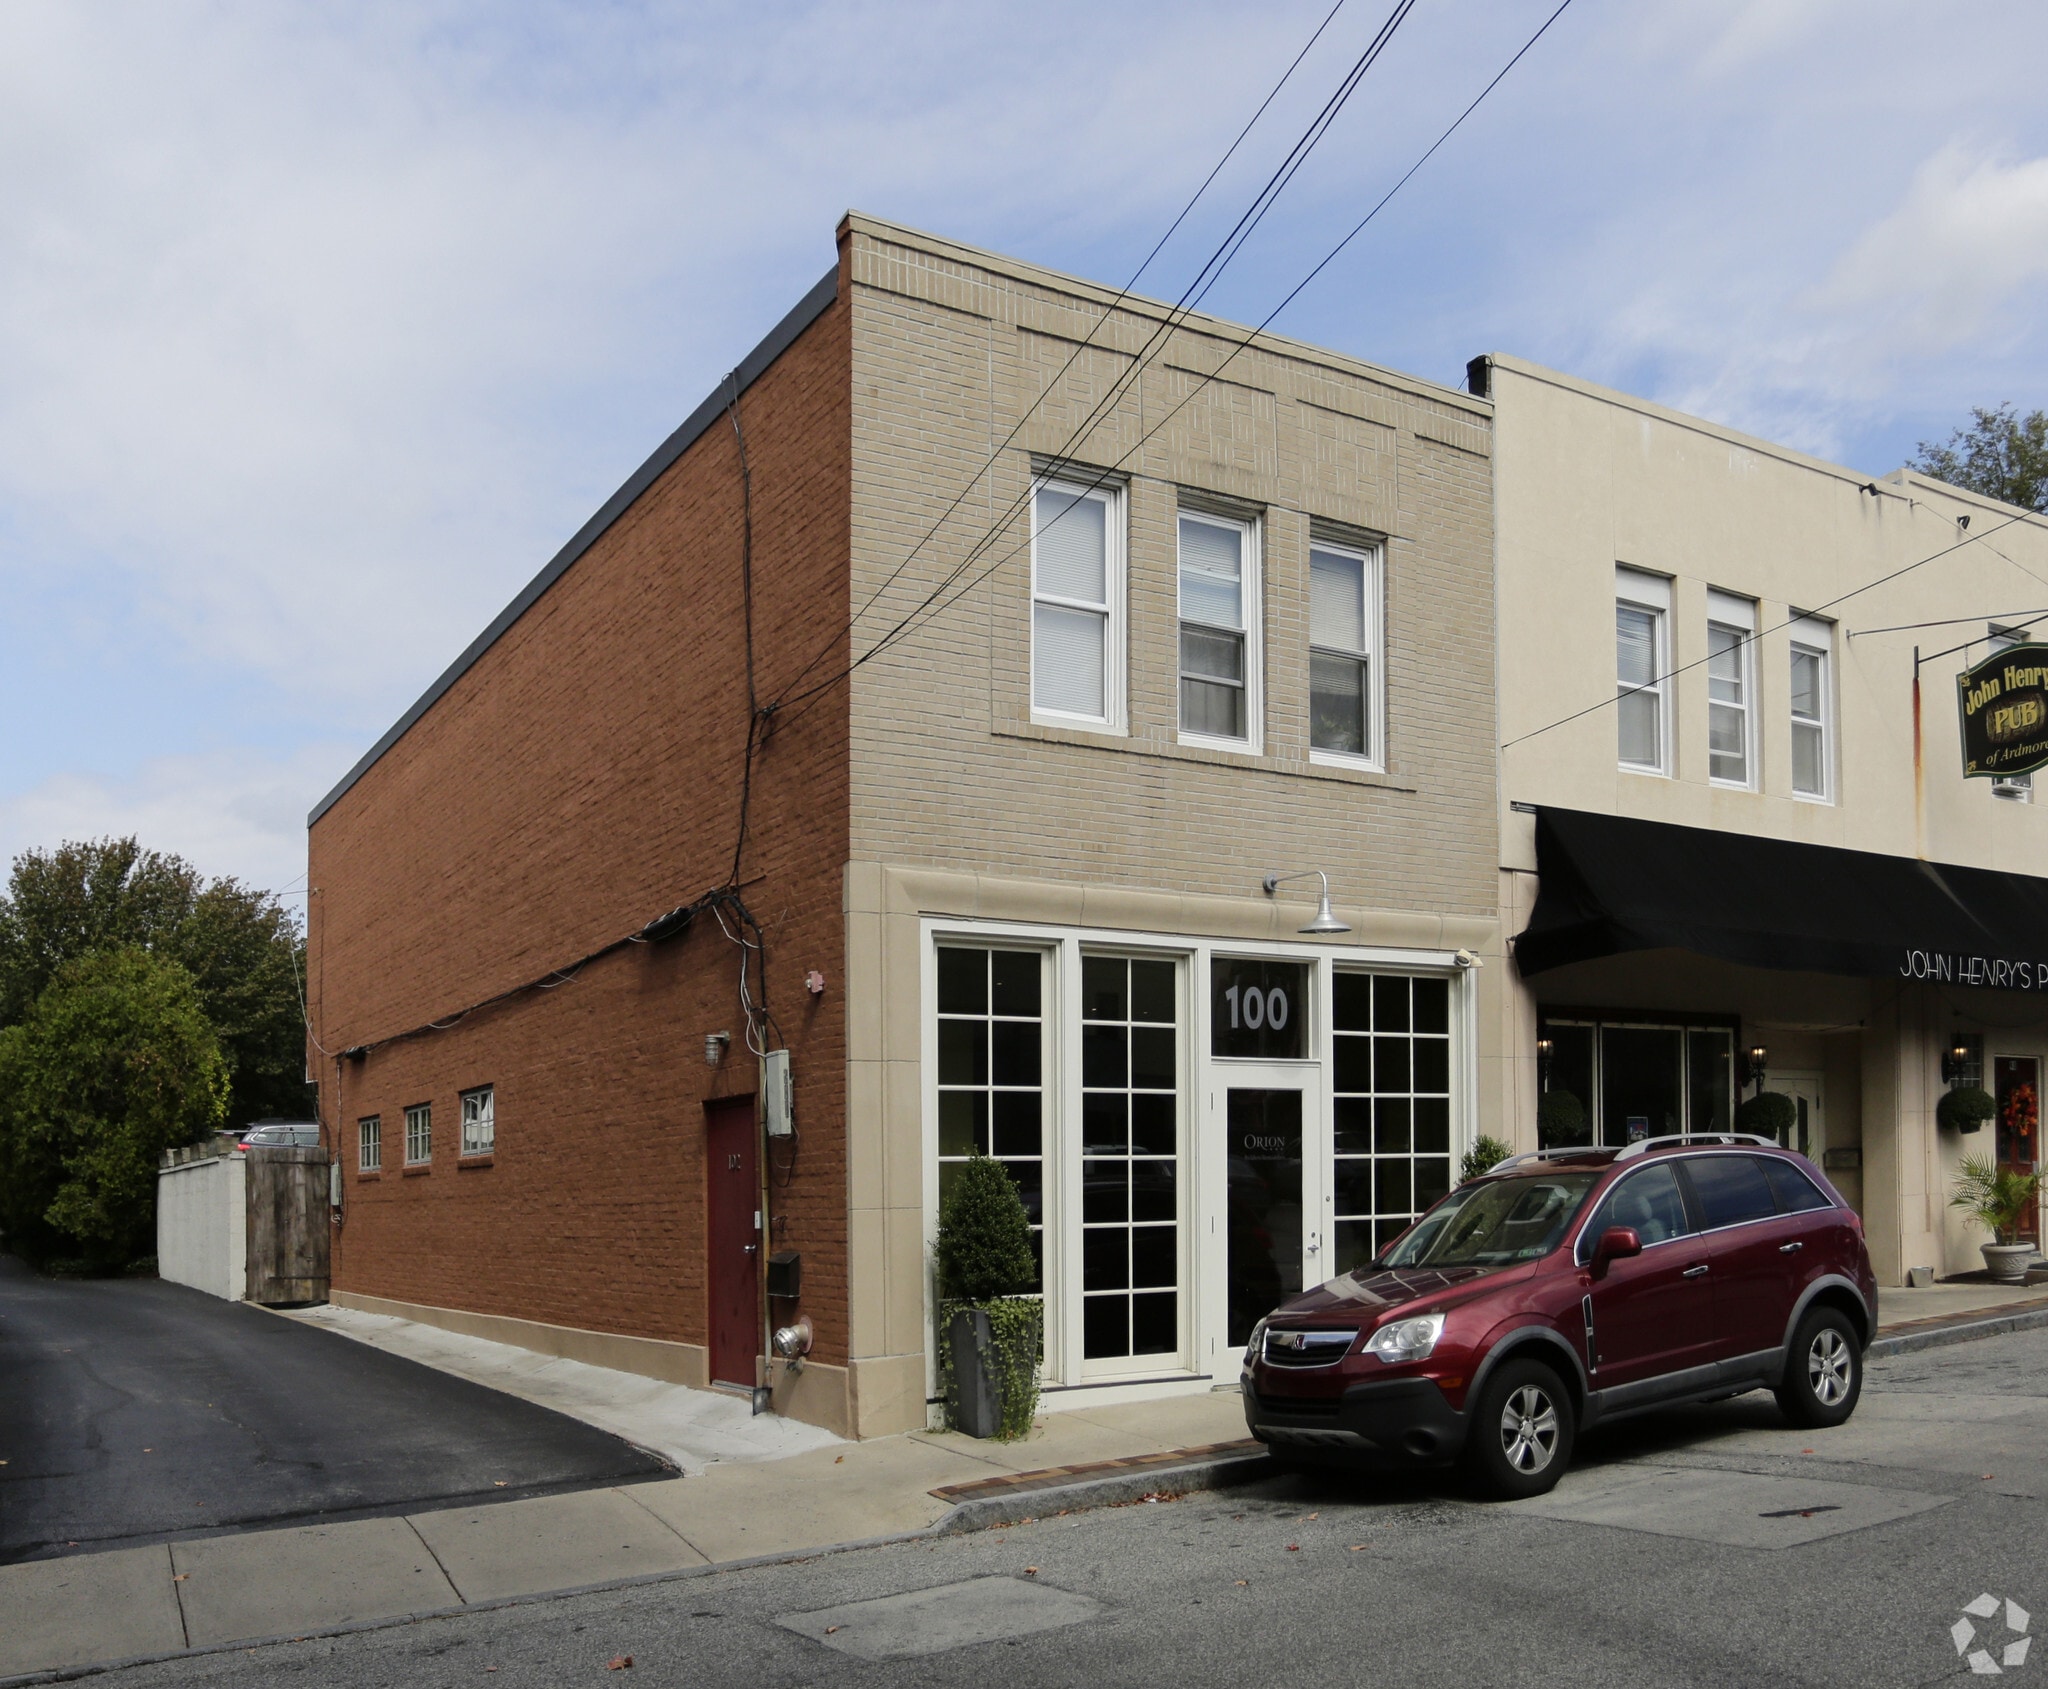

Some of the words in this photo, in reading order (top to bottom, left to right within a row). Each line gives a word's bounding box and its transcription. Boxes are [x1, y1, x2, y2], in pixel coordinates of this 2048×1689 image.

[1967, 679, 2000, 715] John
[1995, 702, 2038, 734] PUB
[1987, 751, 1998, 767] of
[1900, 950, 1951, 982] JOHN
[1958, 956, 2031, 989] HENRY'S
[1225, 985, 1288, 1031] 100
[1244, 1133, 1285, 1151] ORION
